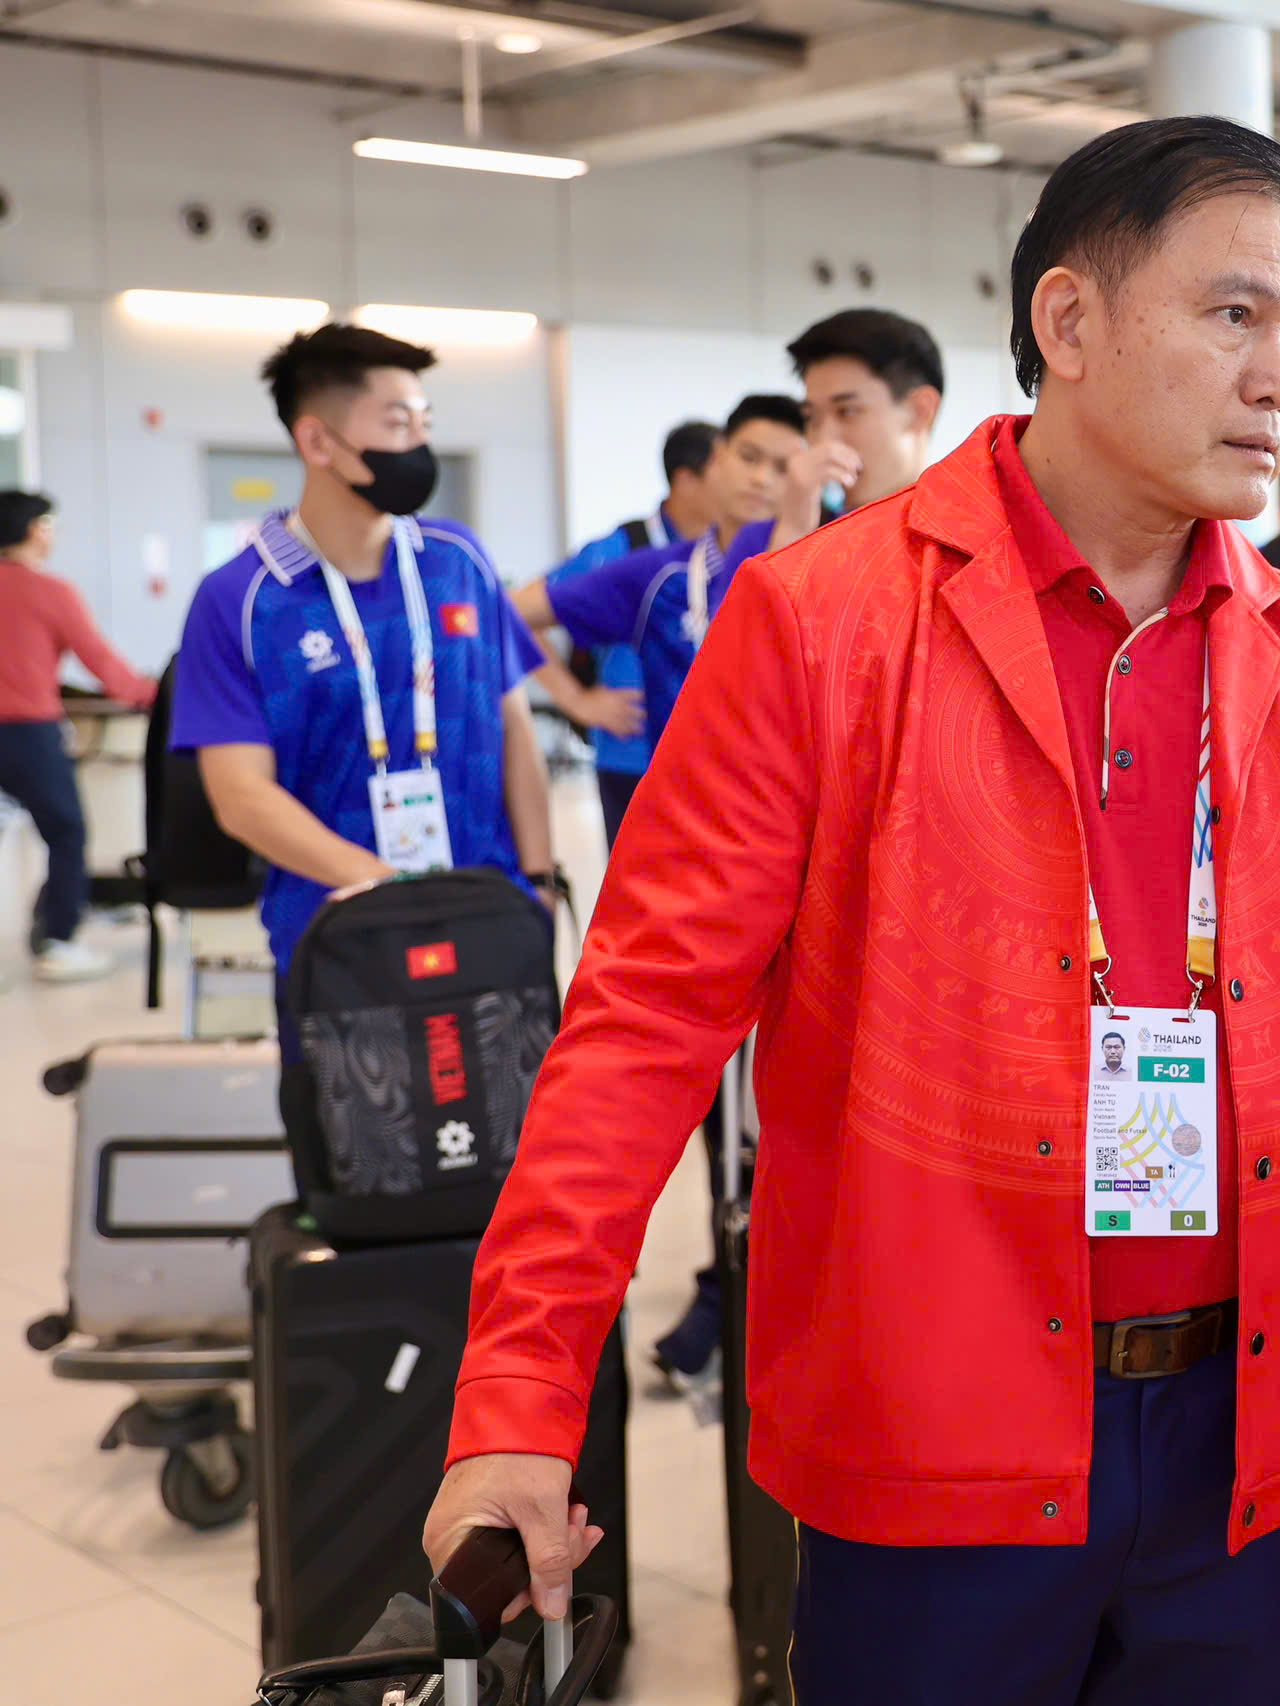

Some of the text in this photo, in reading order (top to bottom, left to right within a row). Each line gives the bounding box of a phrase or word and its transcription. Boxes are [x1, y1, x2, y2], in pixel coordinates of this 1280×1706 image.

[1153, 1034, 1202, 1045] THAILAND
[1153, 1063, 1190, 1078] F-02
[1108, 1214, 1118, 1226] S
